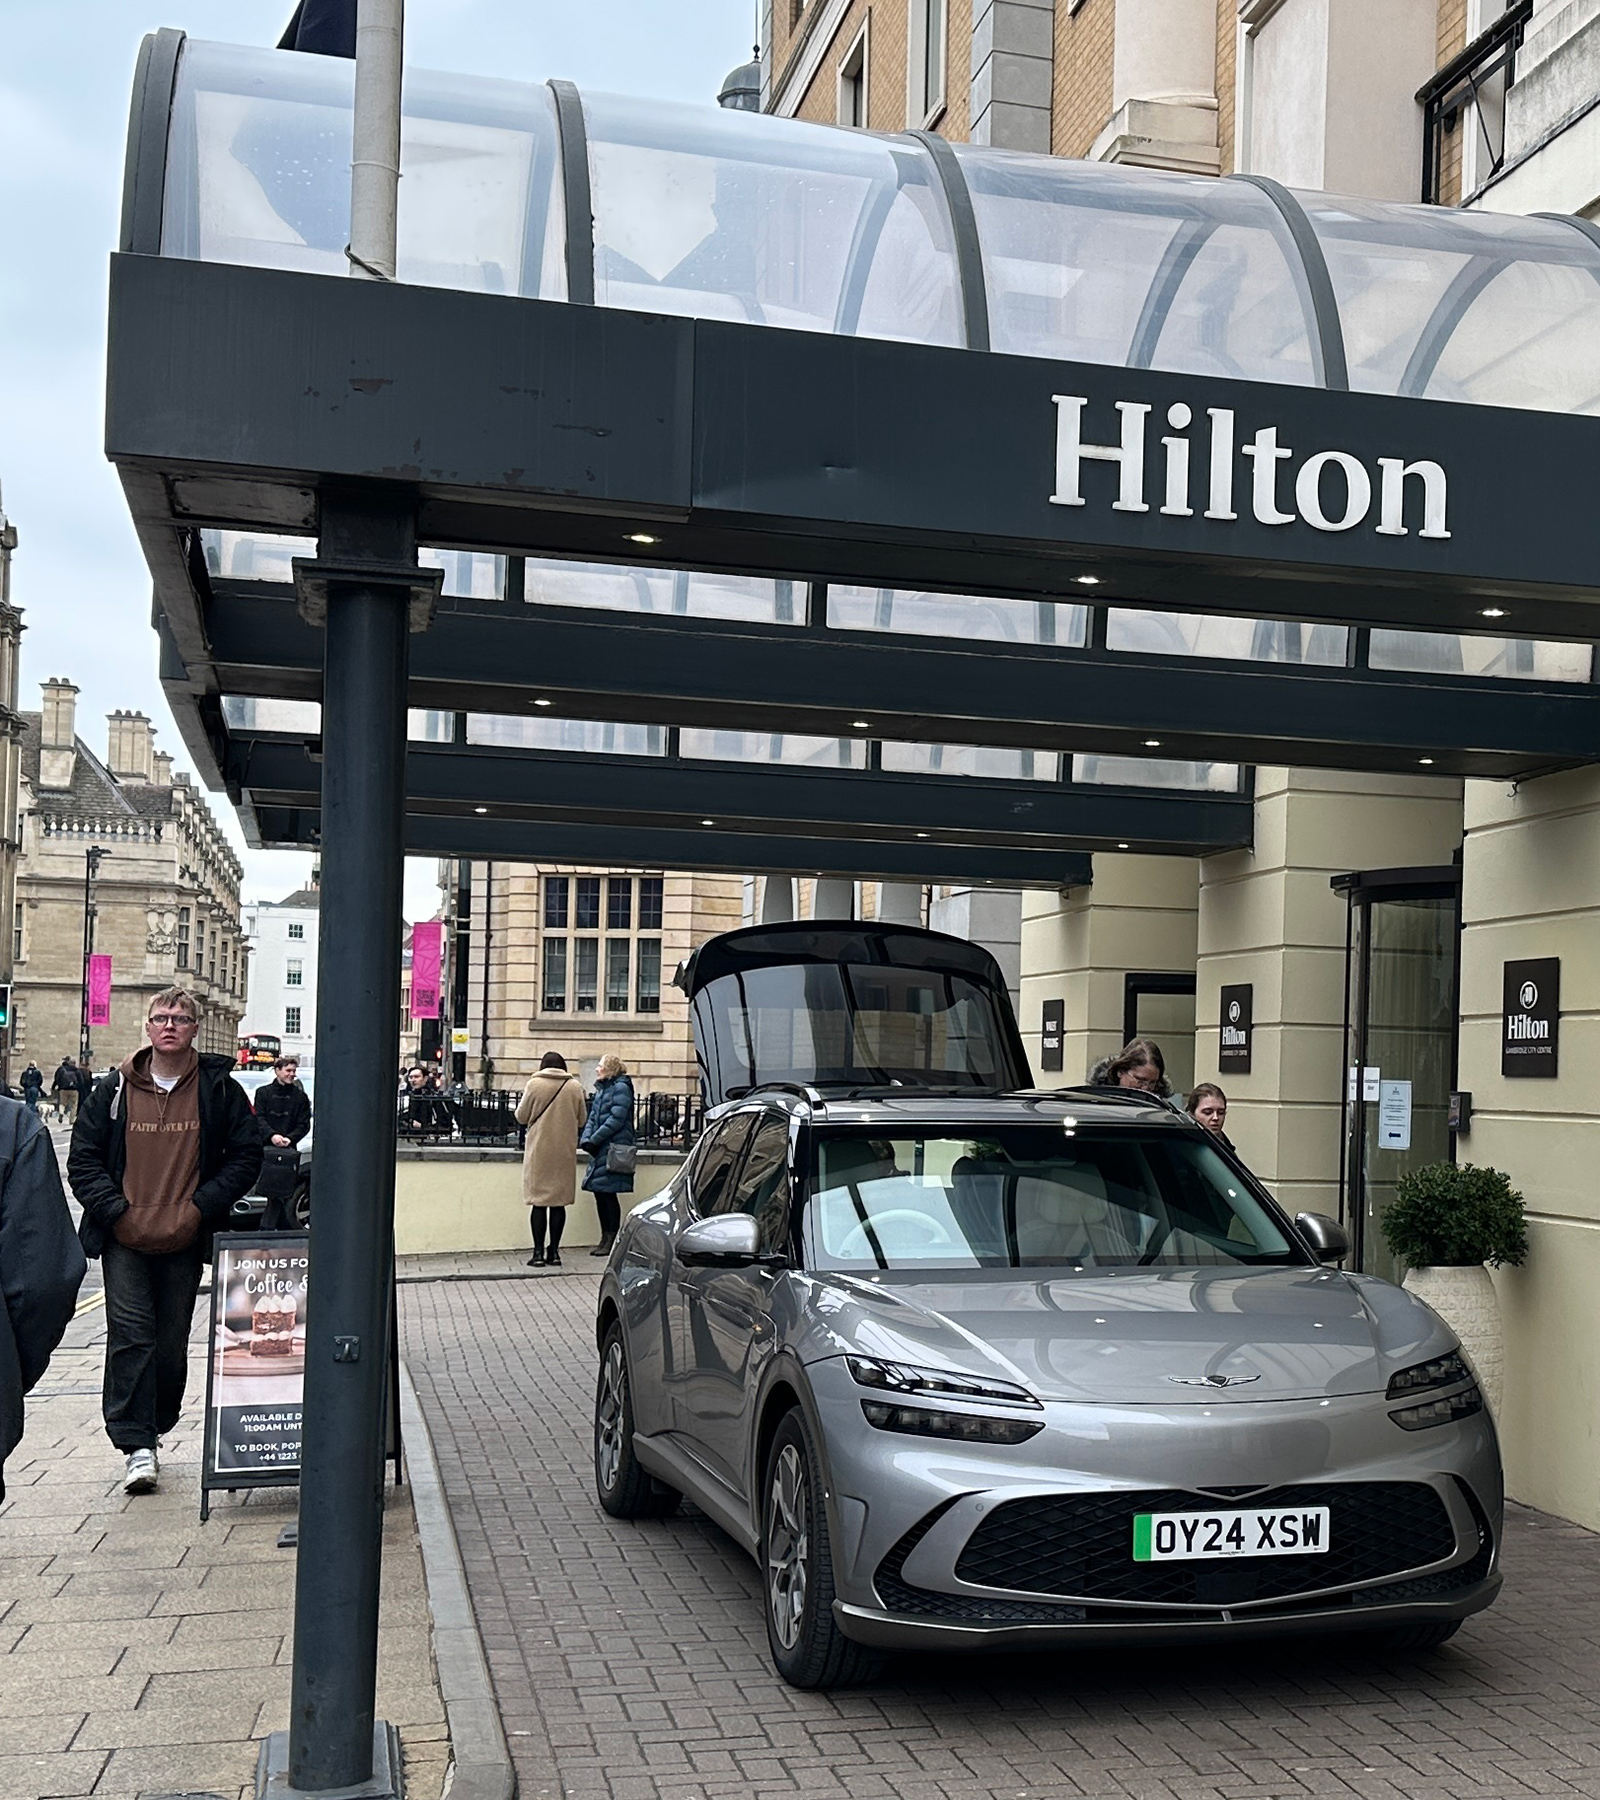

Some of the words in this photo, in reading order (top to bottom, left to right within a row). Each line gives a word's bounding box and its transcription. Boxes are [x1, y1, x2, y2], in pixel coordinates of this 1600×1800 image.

[1048, 394, 1452, 539] Hilton
[1507, 1013, 1549, 1040] Hilton
[1221, 1025, 1246, 1045] Hilton
[130, 1122, 158, 1132] FAITH
[160, 1122, 183, 1132] OVER
[233, 1260, 266, 1270] JOIN
[269, 1259, 287, 1269] US
[290, 1258, 309, 1268] FO
[244, 1272, 293, 1294] Coffee
[240, 1413, 293, 1423] AVAILABLE
[234, 1444, 247, 1453] TO
[259, 1453, 275, 1461] +44
[1156, 1516, 1245, 1554] OY24
[1256, 1513, 1321, 1550] XSW
